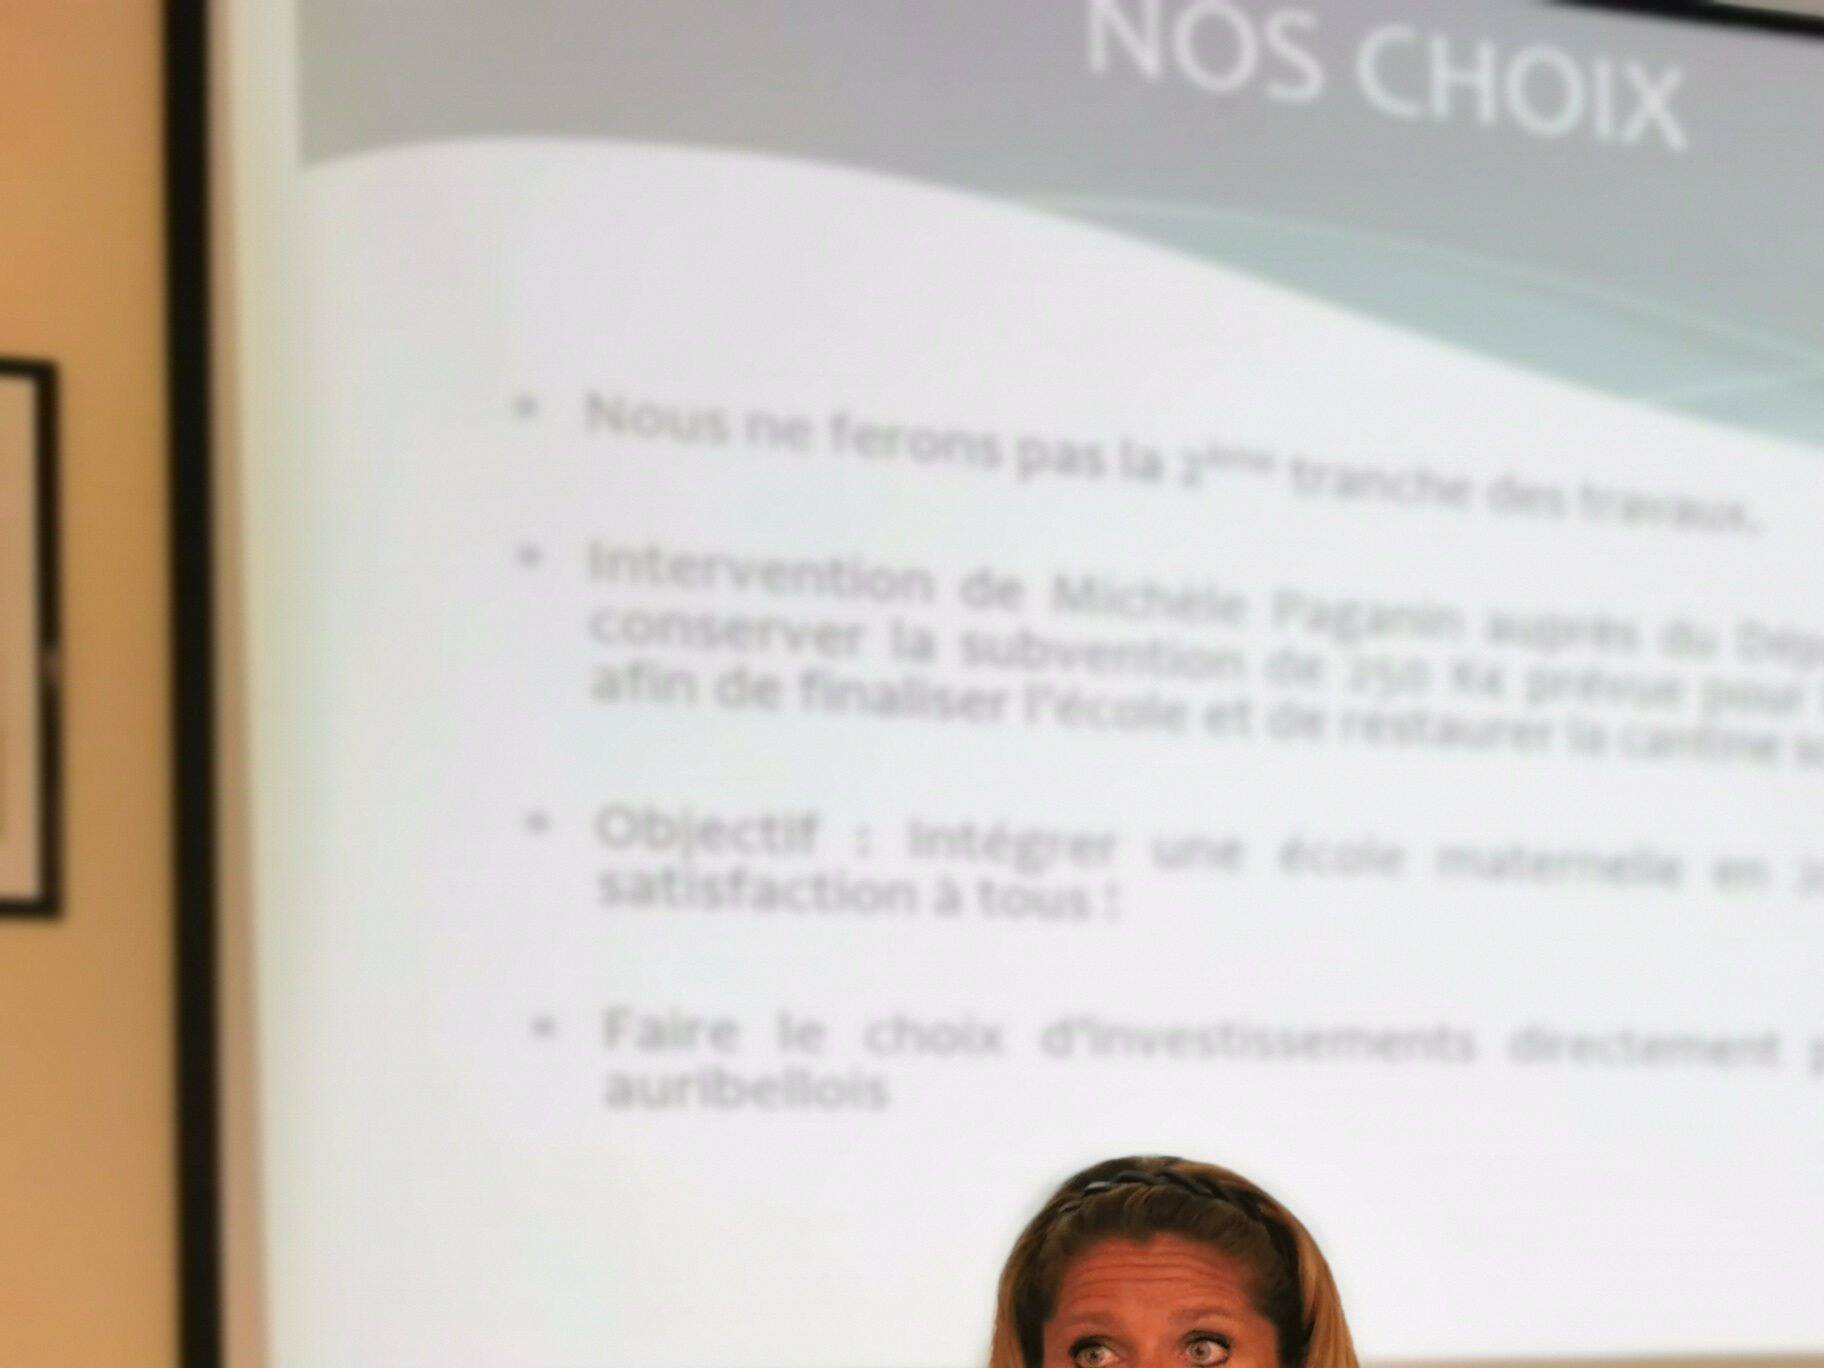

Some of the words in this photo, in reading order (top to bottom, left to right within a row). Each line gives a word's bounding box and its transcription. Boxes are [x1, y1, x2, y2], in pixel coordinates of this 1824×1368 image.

[1088, 0, 1325, 103] NOS
[1356, 22, 1688, 153] CHOIX
[584, 391, 730, 447] Nous
[746, 408, 813, 452] ne
[829, 408, 1002, 471] ferons
[1016, 433, 1105, 484] pas
[1119, 437, 1164, 484] la
[1289, 455, 1471, 510] tranche
[1488, 474, 1564, 521] des
[1579, 483, 1767, 537] travaux.
[588, 539, 935, 603] Intervention
[959, 566, 1024, 611] de
[1052, 572, 1248, 624] Michèle
[1274, 588, 1462, 644] Paganin
[1486, 606, 1639, 660] auprès
[1661, 616, 1718, 658] du
[588, 606, 865, 658] conserver
[891, 618, 936, 664] la
[960, 626, 1244, 680] subvention
[1266, 645, 1322, 687] de
[1348, 654, 1429, 699] 250
[1526, 660, 1680, 708] prévue
[1702, 674, 1802, 721] pour
[590, 659, 696, 706] afin
[714, 664, 782, 711] de
[799, 667, 1010, 722] finaliser
[1204, 698, 1252, 737] et
[1266, 700, 1324, 743] de
[1341, 704, 1551, 754] restaurer
[1568, 710, 1607, 757] la
[1619, 717, 1779, 765] cantine
[594, 803, 819, 864] Objectif
[907, 815, 1116, 876] Intégrer
[1151, 833, 1246, 874] une
[1278, 833, 1403, 880] école
[1435, 841, 1682, 890] maternelle
[1711, 855, 1770, 893] en
[598, 868, 918, 915] satisfaction
[934, 875, 961, 918] à
[978, 879, 1092, 922] tous
[602, 1005, 739, 1053] Faire
[776, 1008, 826, 1054] le
[864, 1013, 1006, 1058] choix
[1507, 1024, 1780, 1072] directement
[602, 1064, 890, 1112] auribellois
